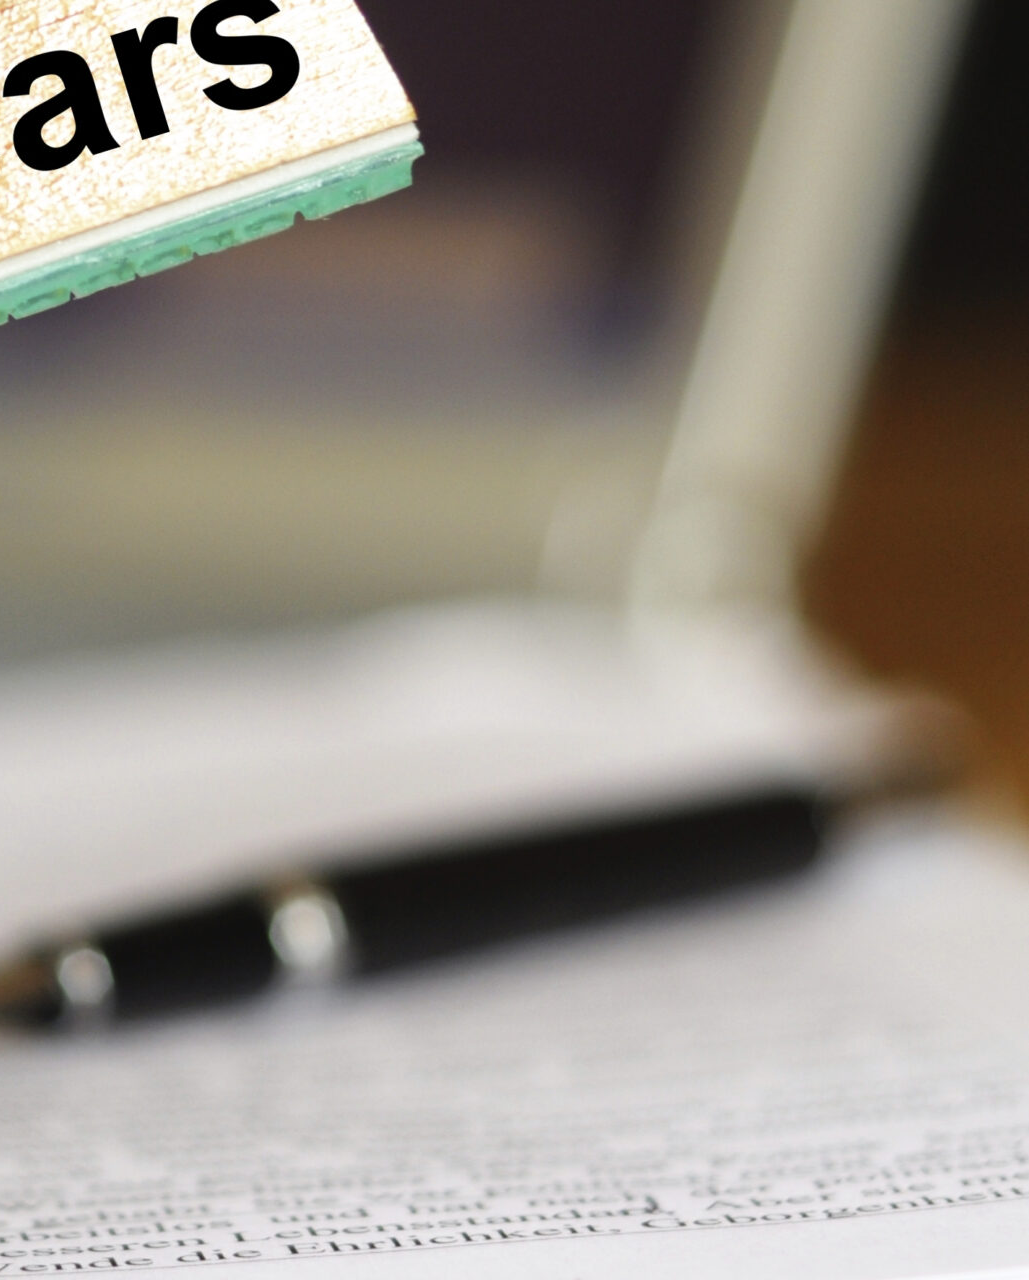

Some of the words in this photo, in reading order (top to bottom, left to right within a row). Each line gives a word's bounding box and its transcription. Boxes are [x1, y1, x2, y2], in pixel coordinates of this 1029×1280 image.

[705, 1194, 832, 1211] Aber
[862, 1182, 933, 1198] sie
[270, 1206, 369, 1223] und
[409, 1201, 486, 1216] hat
[176, 1249, 262, 1263] die
[286, 1223, 619, 1255] Ehrlichkeit,
